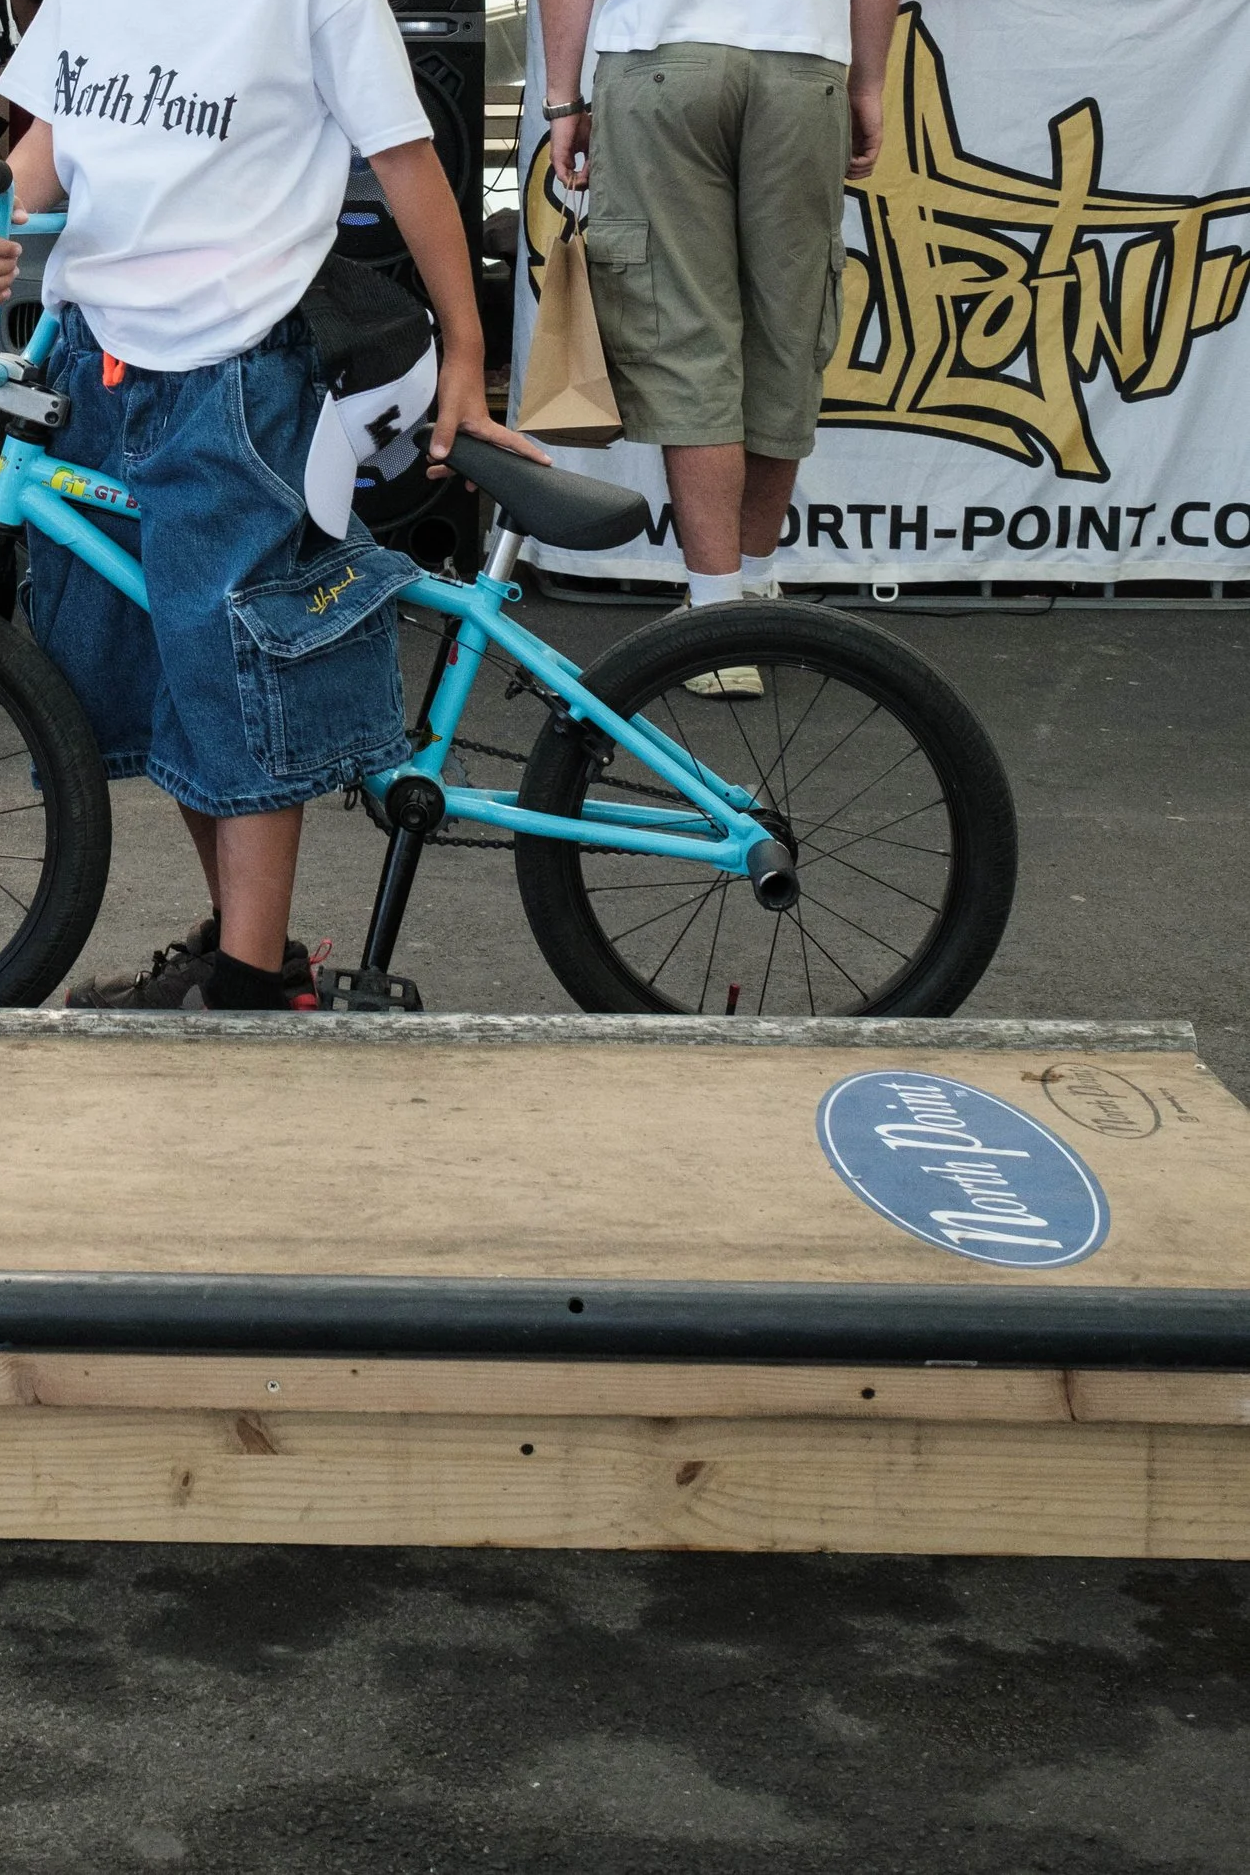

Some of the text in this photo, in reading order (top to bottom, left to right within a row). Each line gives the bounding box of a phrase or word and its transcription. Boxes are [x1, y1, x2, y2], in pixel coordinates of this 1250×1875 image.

[54, 50, 238, 142] North Point
[94, 485, 122, 504] GT
[874, 1081, 1063, 1249] North Point
